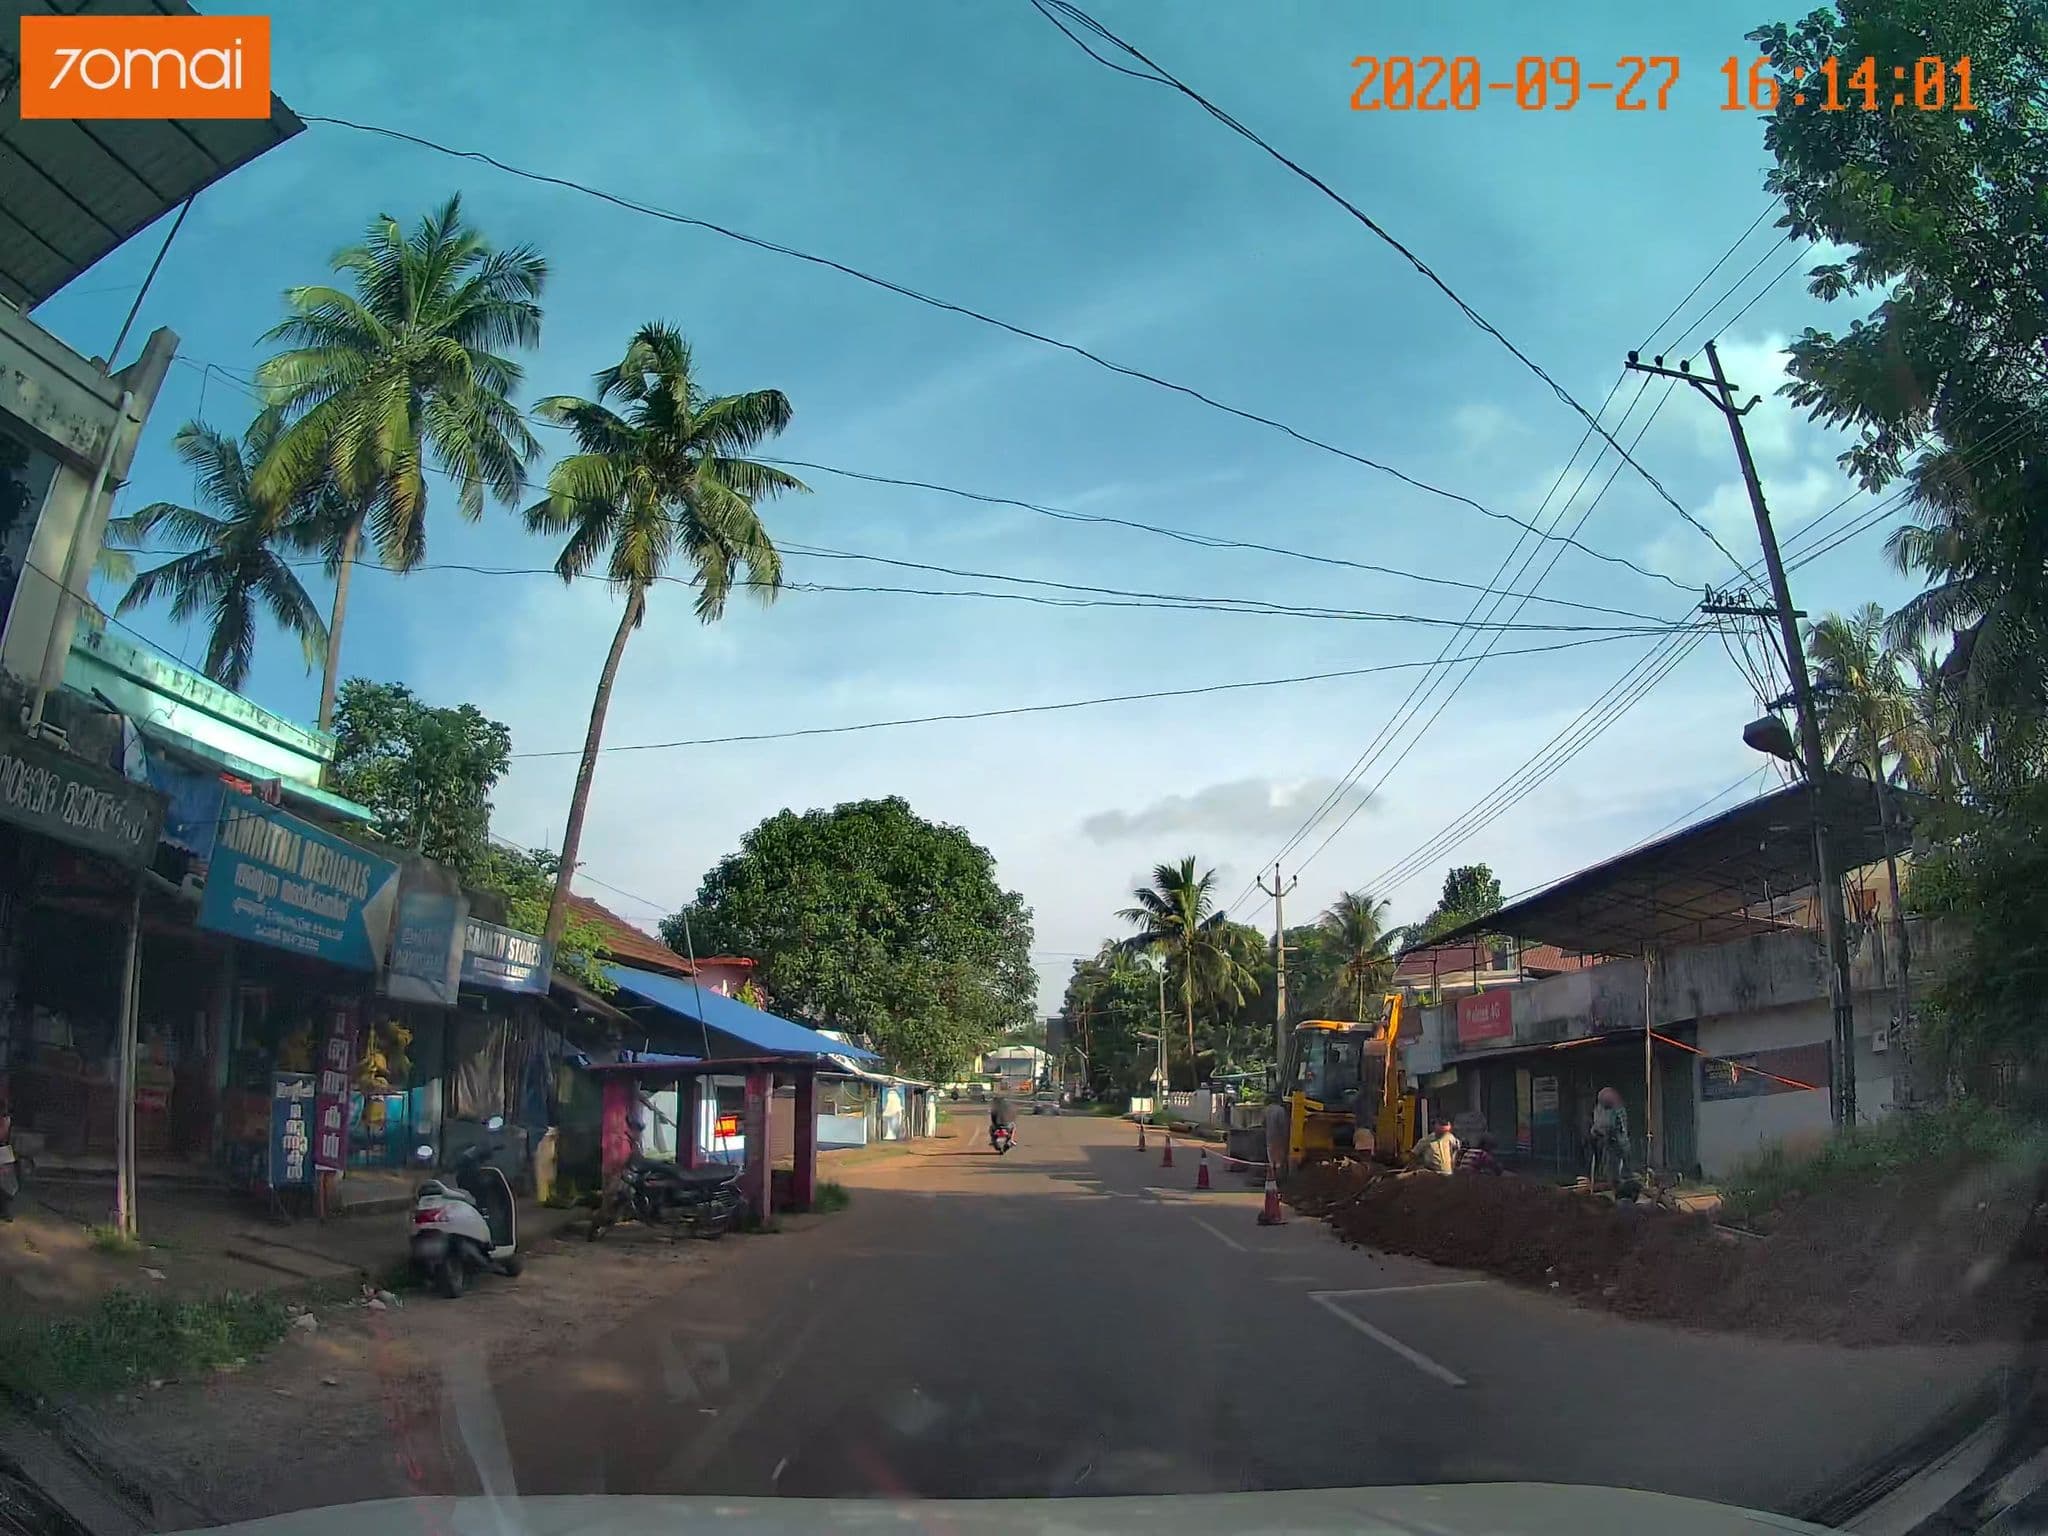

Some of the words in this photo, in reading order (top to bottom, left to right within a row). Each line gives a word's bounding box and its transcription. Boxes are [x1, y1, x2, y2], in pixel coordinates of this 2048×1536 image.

[223, 807, 303, 874] AMRITHA
[300, 839, 372, 900] MEDICALS
[508, 937, 541, 966] STORES
